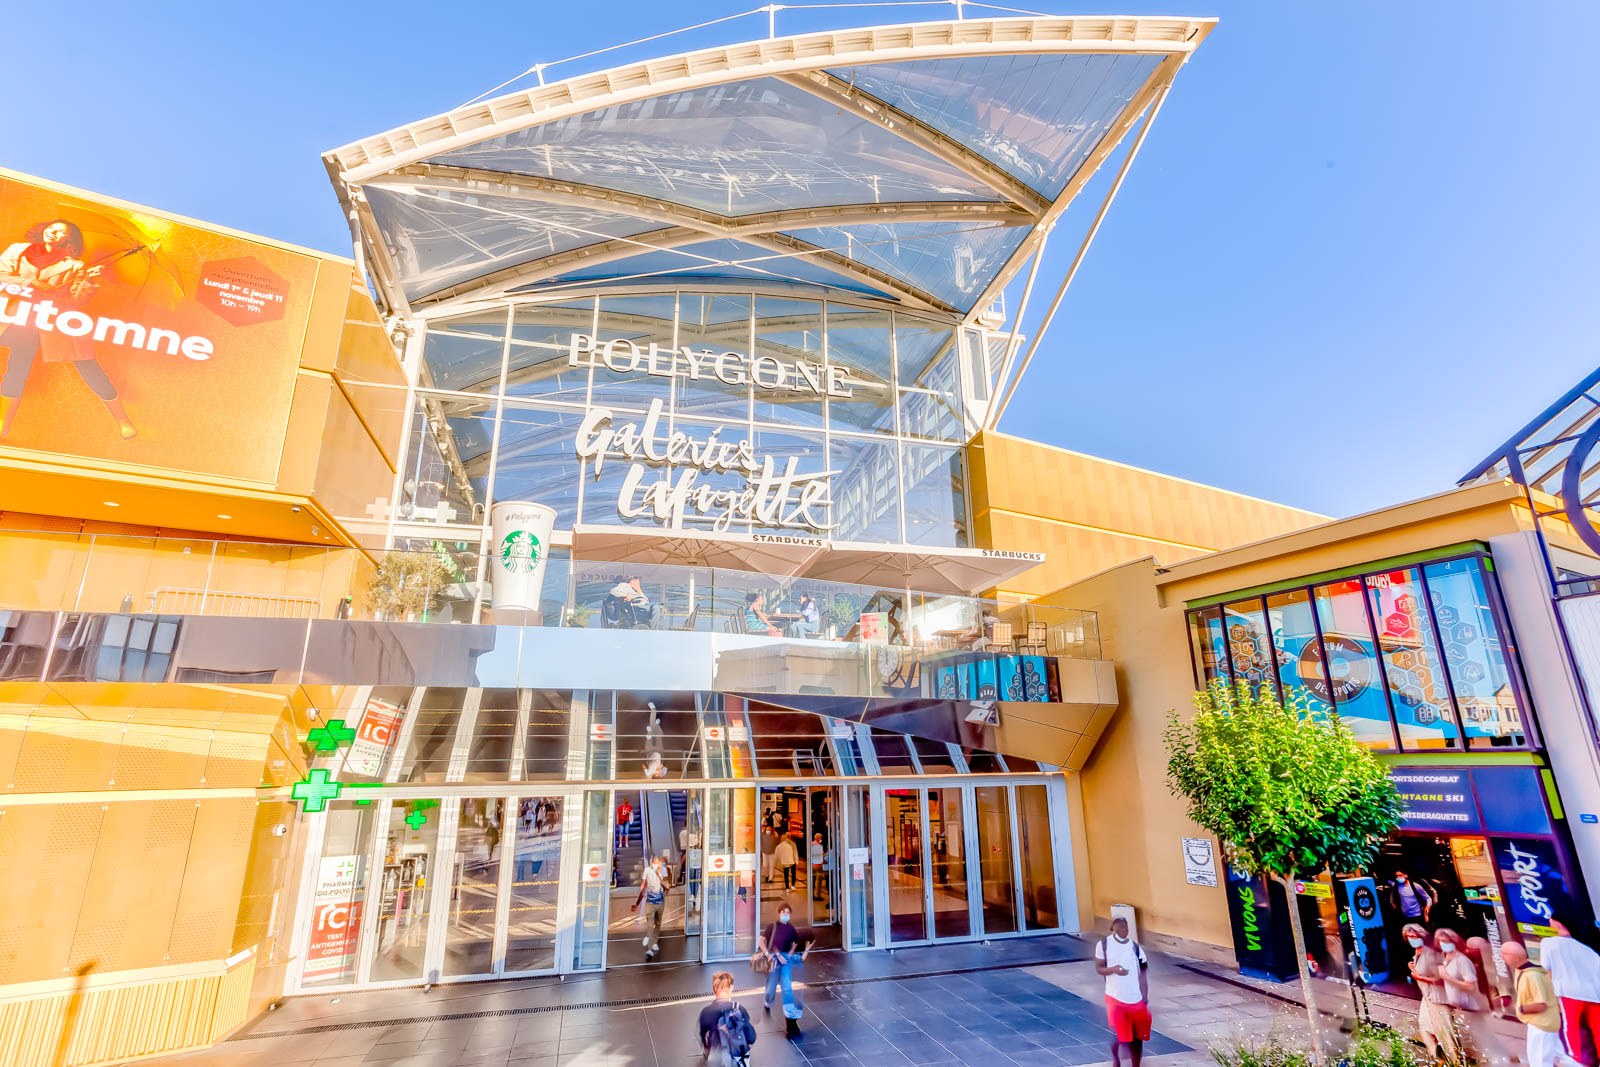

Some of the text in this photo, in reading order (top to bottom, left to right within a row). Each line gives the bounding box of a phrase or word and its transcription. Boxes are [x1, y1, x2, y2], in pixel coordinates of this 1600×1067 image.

[203, 278, 230, 290] Lundi
[242, 287, 249, 295] &
[250, 289, 273, 300] jeudi
[275, 295, 283, 303] 11
[219, 291, 265, 306] novembre
[221, 298, 236, 308] 10h
[247, 304, 261, 313] 19h
[569, 333, 852, 398] POLYGONE
[575, 398, 758, 482] Galeries
[617, 454, 842, 532] Lafayette
[752, 534, 822, 547] STARBUCKS
[981, 549, 1041, 561] STARBUCKS
[1312, 641, 1344, 657] FRUM
[1394, 793, 1464, 802] ONTAGNE SKI
[1504, 841, 1552, 920] SPORT
[1238, 886, 1262, 951] VIVONS
